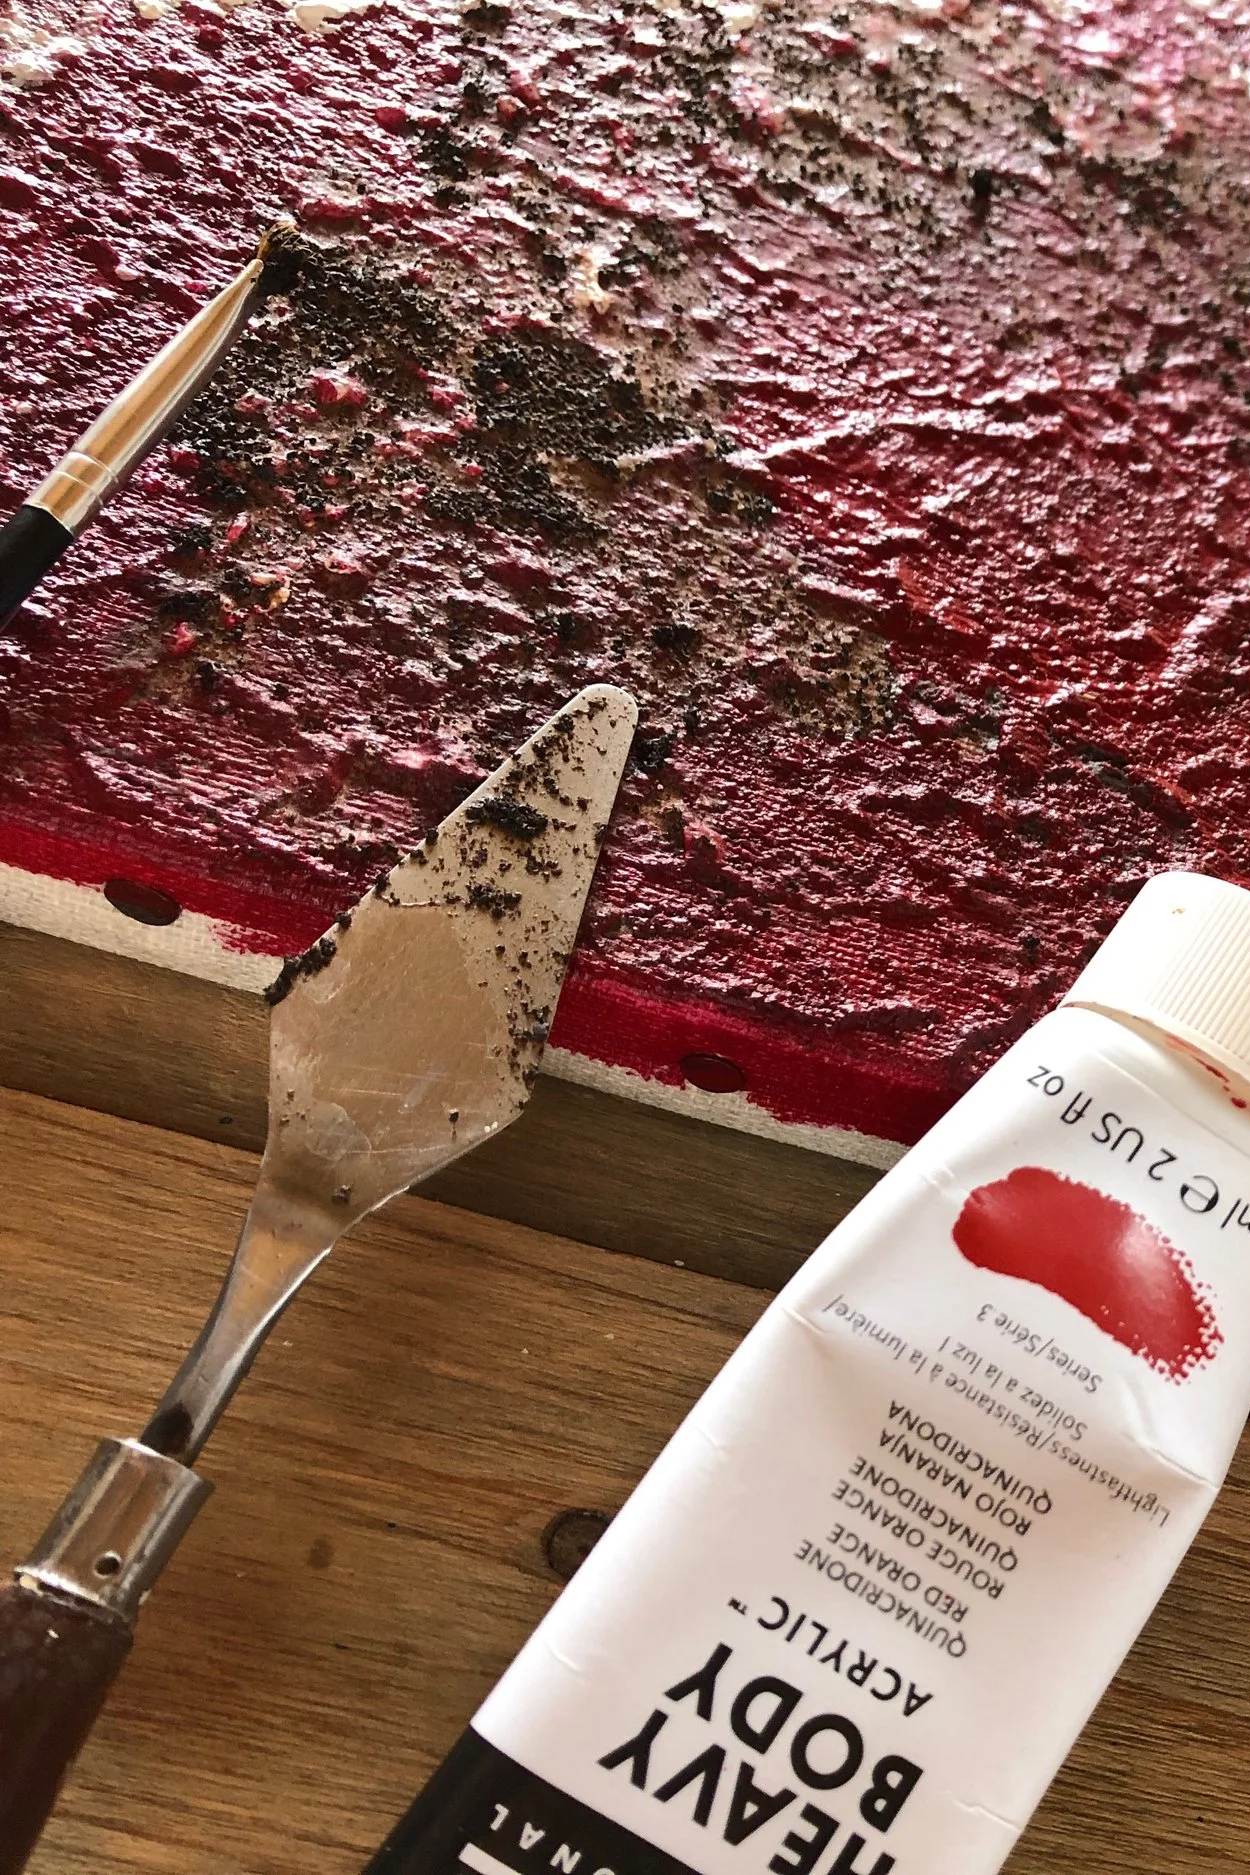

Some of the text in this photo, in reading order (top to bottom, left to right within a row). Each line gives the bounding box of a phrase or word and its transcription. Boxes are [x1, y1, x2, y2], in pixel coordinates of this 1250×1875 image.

[1026, 1065, 1065, 1097] oz
[1060, 1091, 1093, 1125] fl
[1091, 1112, 1144, 1163] US
[1147, 1148, 1177, 1181] 2
[976, 1303, 994, 1322] 3
[909, 1349, 928, 1374] la
[930, 1363, 944, 1382] à
[952, 1342, 983, 1375] luz
[984, 1363, 1004, 1389] la
[1005, 1377, 1019, 1392] a
[1019, 1386, 1088, 1441] Solidez
[888, 1400, 1053, 1515] QUINACRIDONA
[879, 1428, 1032, 1537] ROJO NARANJA
[851, 1456, 1018, 1572] QUINACRIDONE
[831, 1480, 1005, 1600] ROUGE ORANGE
[827, 1523, 969, 1623] RED ORANGE
[794, 1539, 968, 1658] QUINACRIDONE
[664, 1643, 924, 1833] BODY
